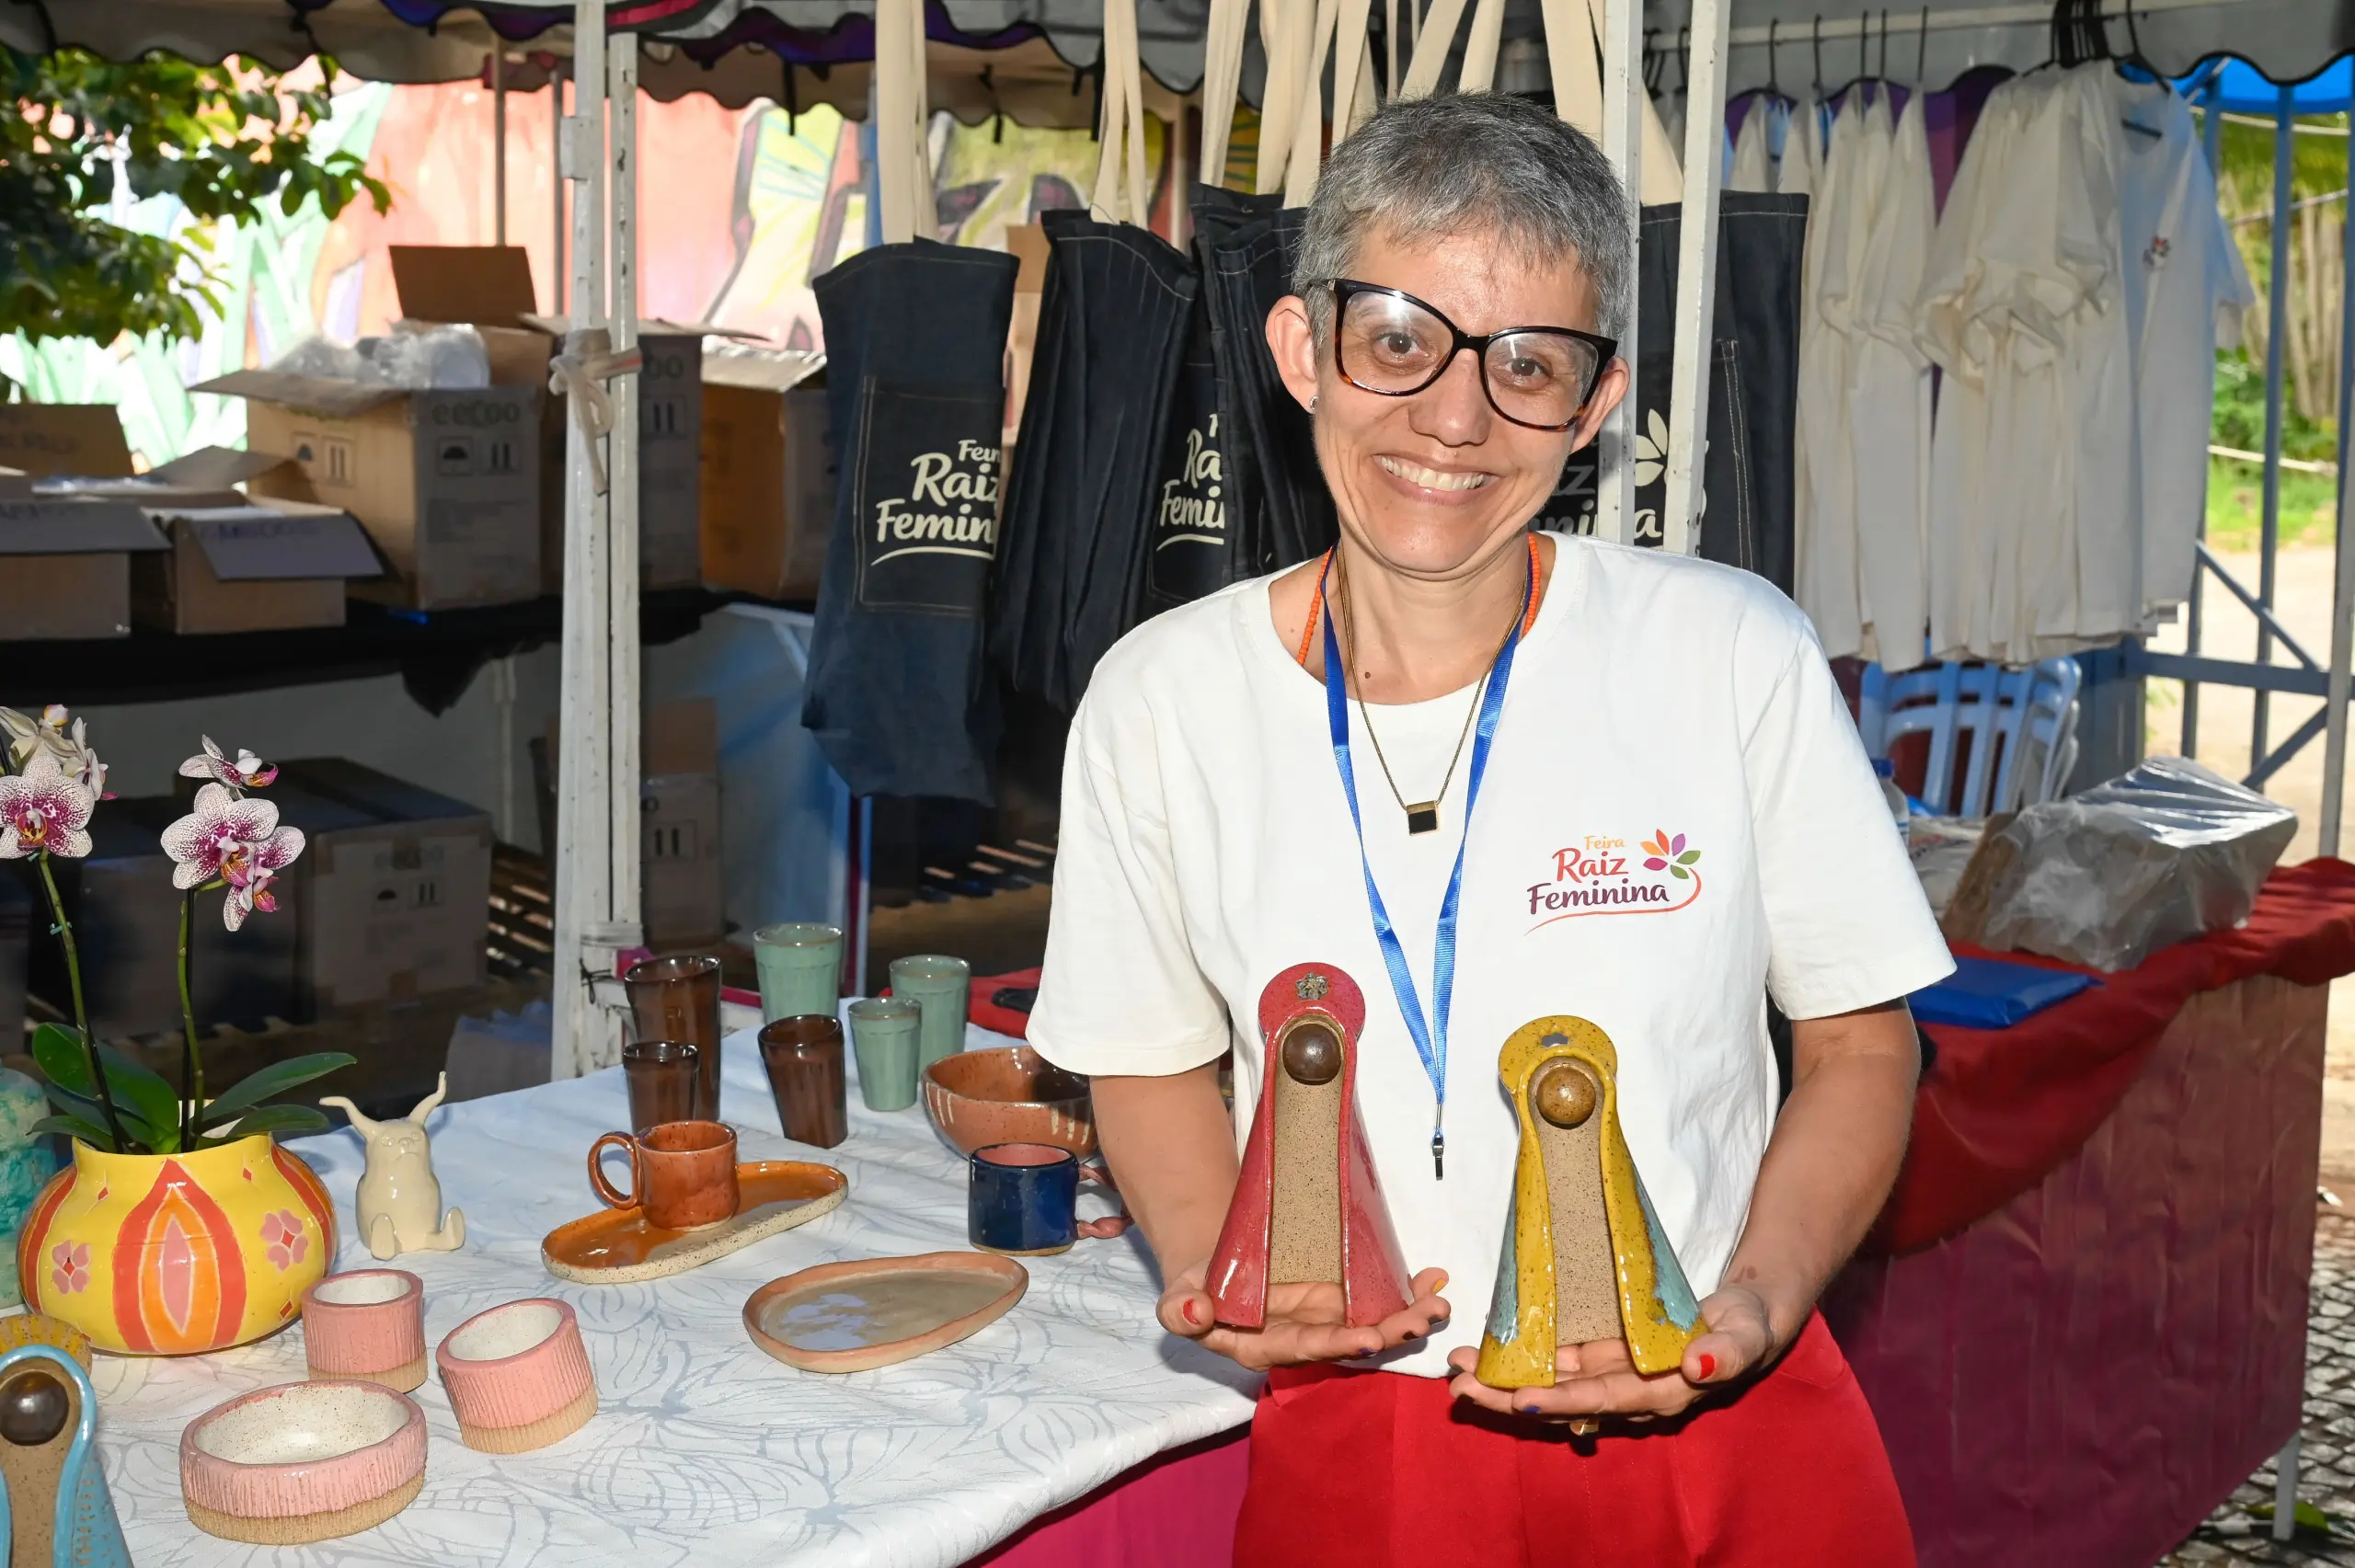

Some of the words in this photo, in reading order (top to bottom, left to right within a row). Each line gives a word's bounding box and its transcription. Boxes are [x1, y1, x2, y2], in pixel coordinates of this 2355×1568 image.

[1184, 429, 1222, 489] Ra
[876, 498, 996, 544] Femin
[1584, 835, 1626, 850] Feira
[1552, 848, 1629, 883] Raiz
[1526, 878, 1670, 914] Feminina
